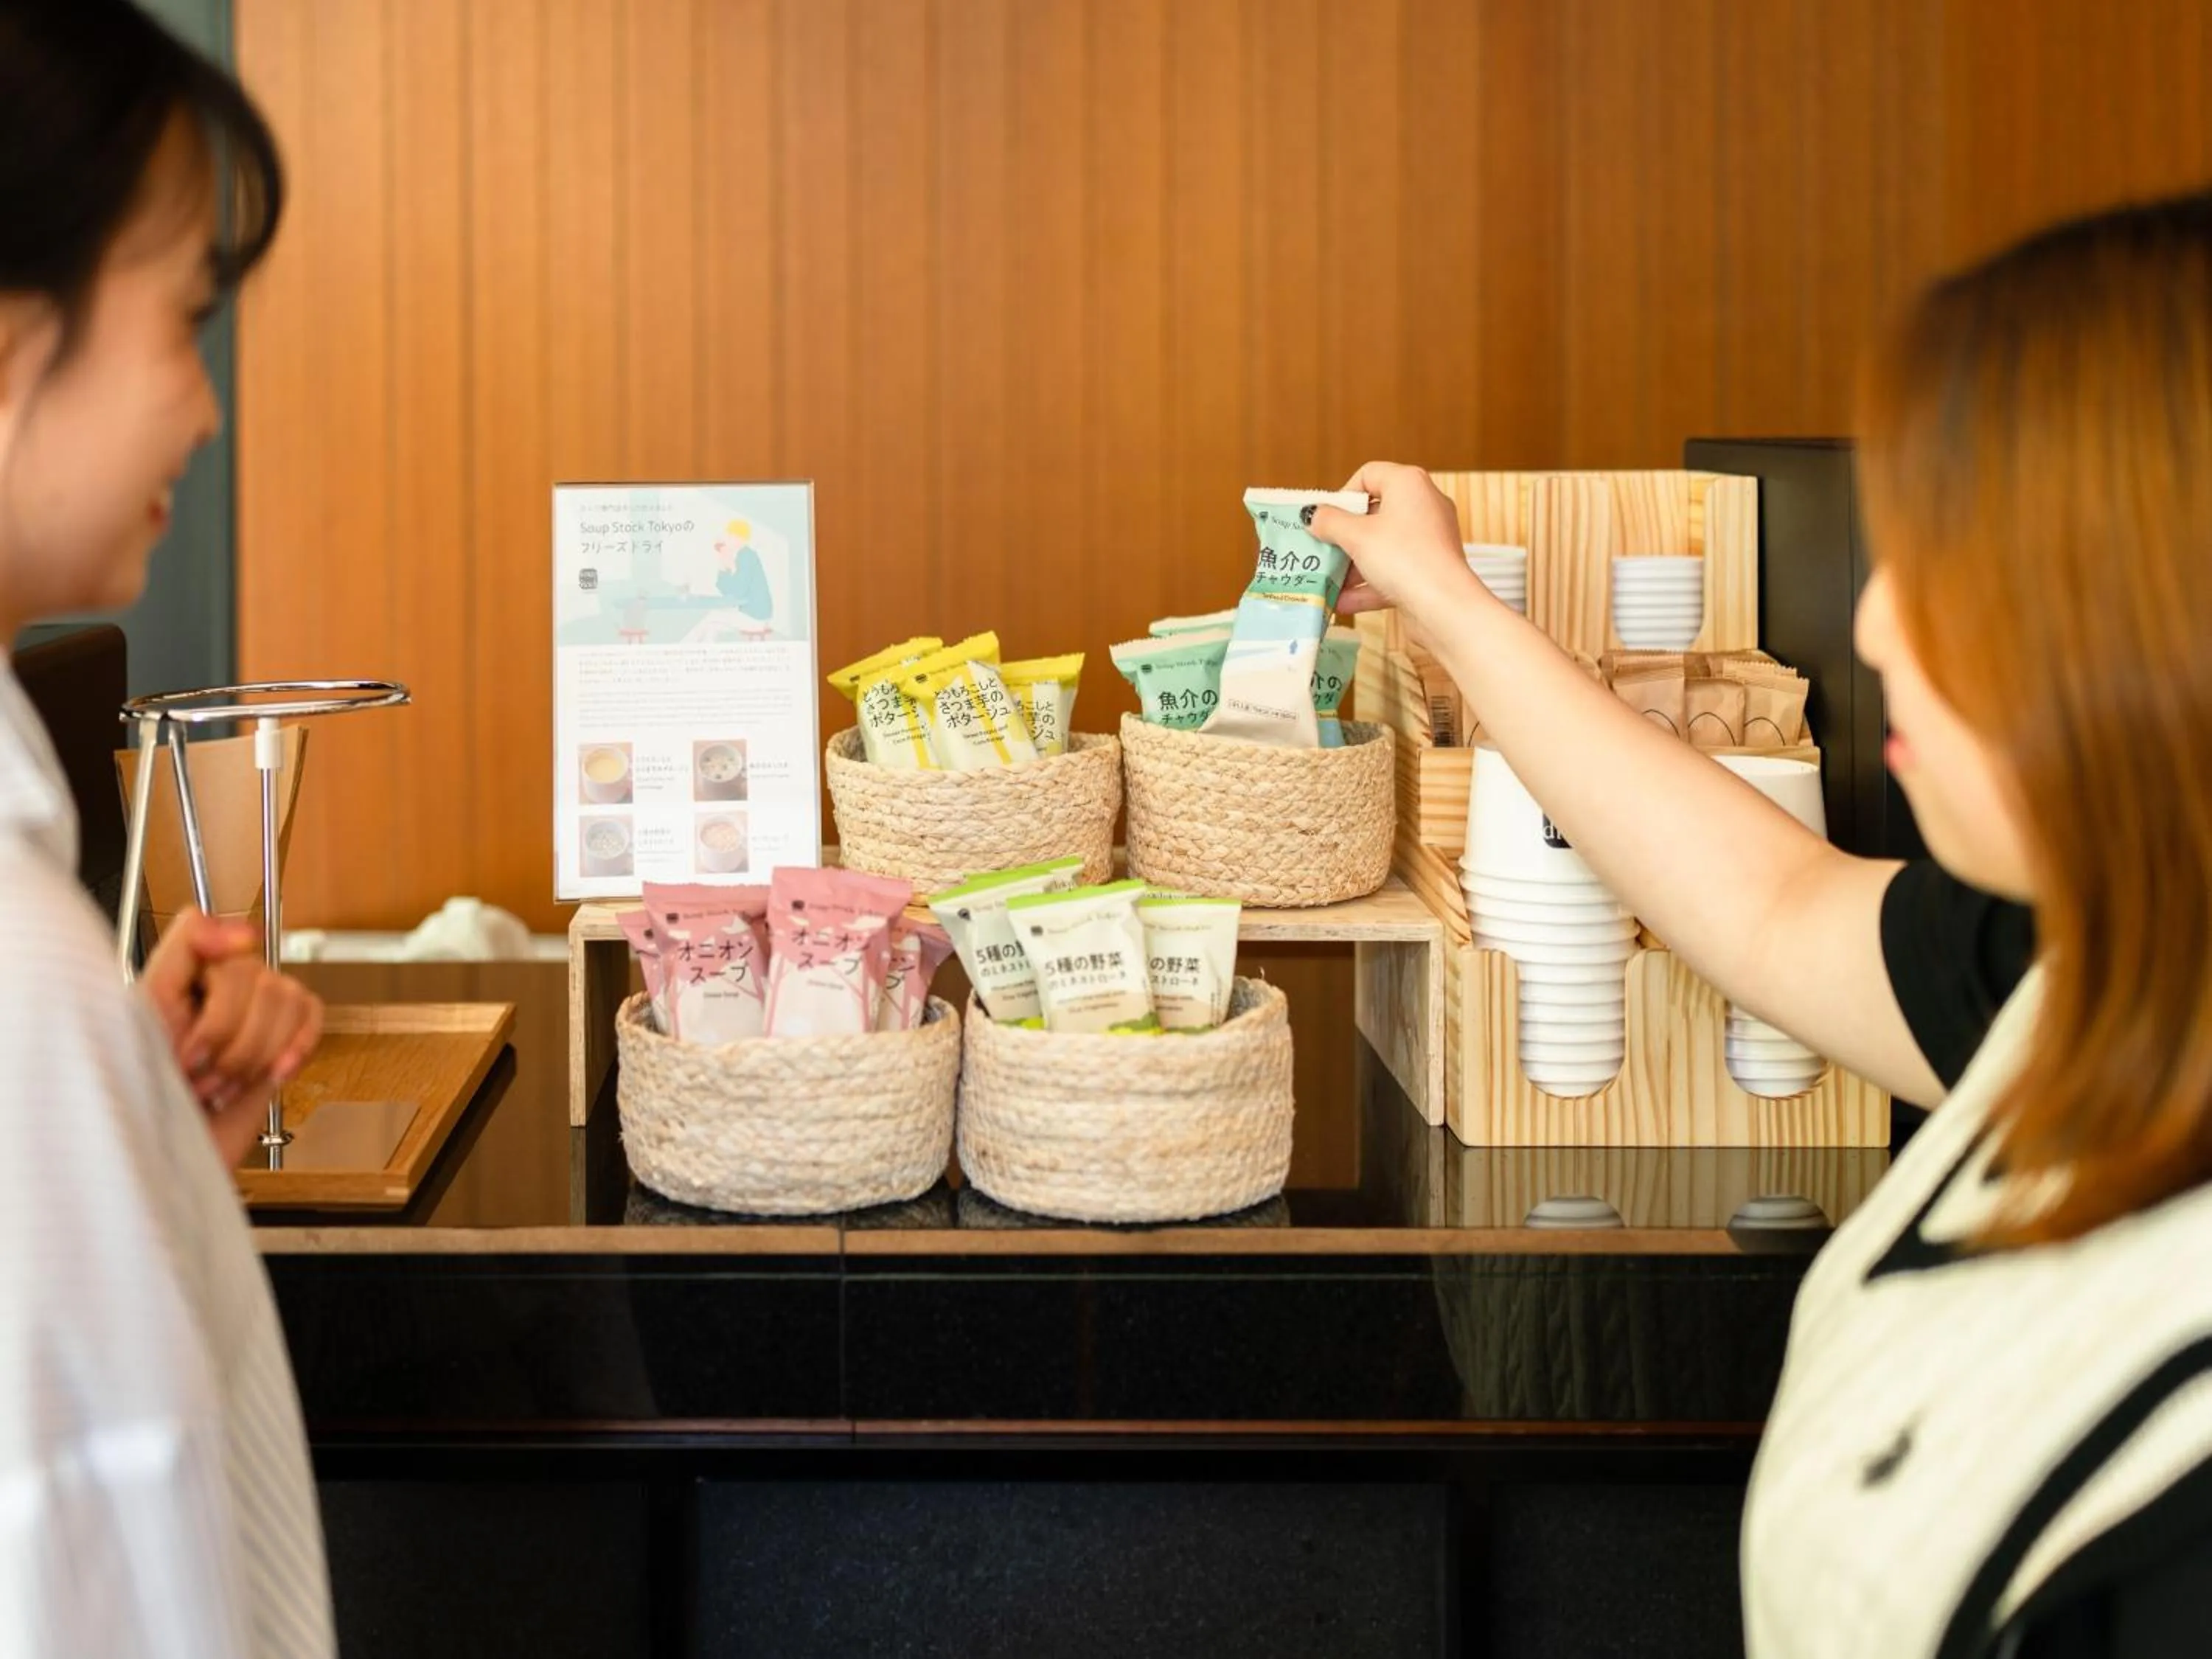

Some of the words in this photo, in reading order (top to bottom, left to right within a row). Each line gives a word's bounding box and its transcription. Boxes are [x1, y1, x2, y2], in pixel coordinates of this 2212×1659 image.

[612, 521, 644, 533] Stock
[1259, 546, 1321, 571] 魚介の
[1256, 571, 1318, 587] チャウダー
[1158, 689, 1218, 710] 魚介の
[947, 705, 1011, 728] ポタージュ
[678, 939, 754, 961] オニオン
[792, 928, 871, 952] オニオン
[690, 961, 750, 984] スープ
[798, 951, 862, 975] スープ
